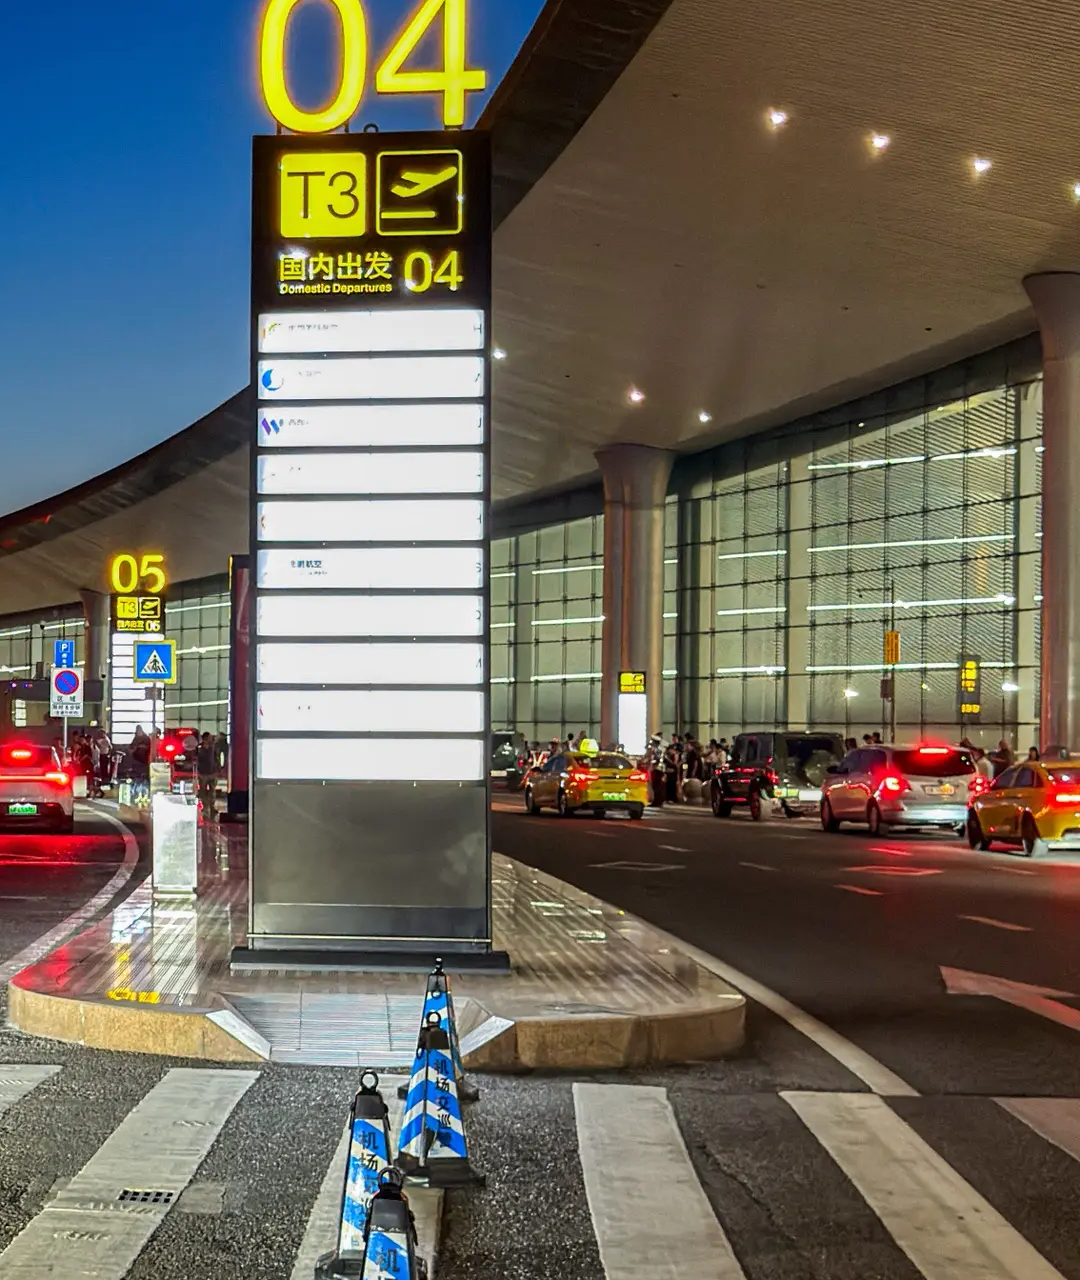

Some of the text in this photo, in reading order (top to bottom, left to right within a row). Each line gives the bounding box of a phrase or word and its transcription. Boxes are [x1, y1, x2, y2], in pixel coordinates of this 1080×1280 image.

[286, 171, 361, 219] T3
[279, 251, 464, 293] 国内出发 04
[279, 282, 393, 295] Domestic Departures
[111, 554, 166, 594] 05
[119, 601, 137, 614] T3
